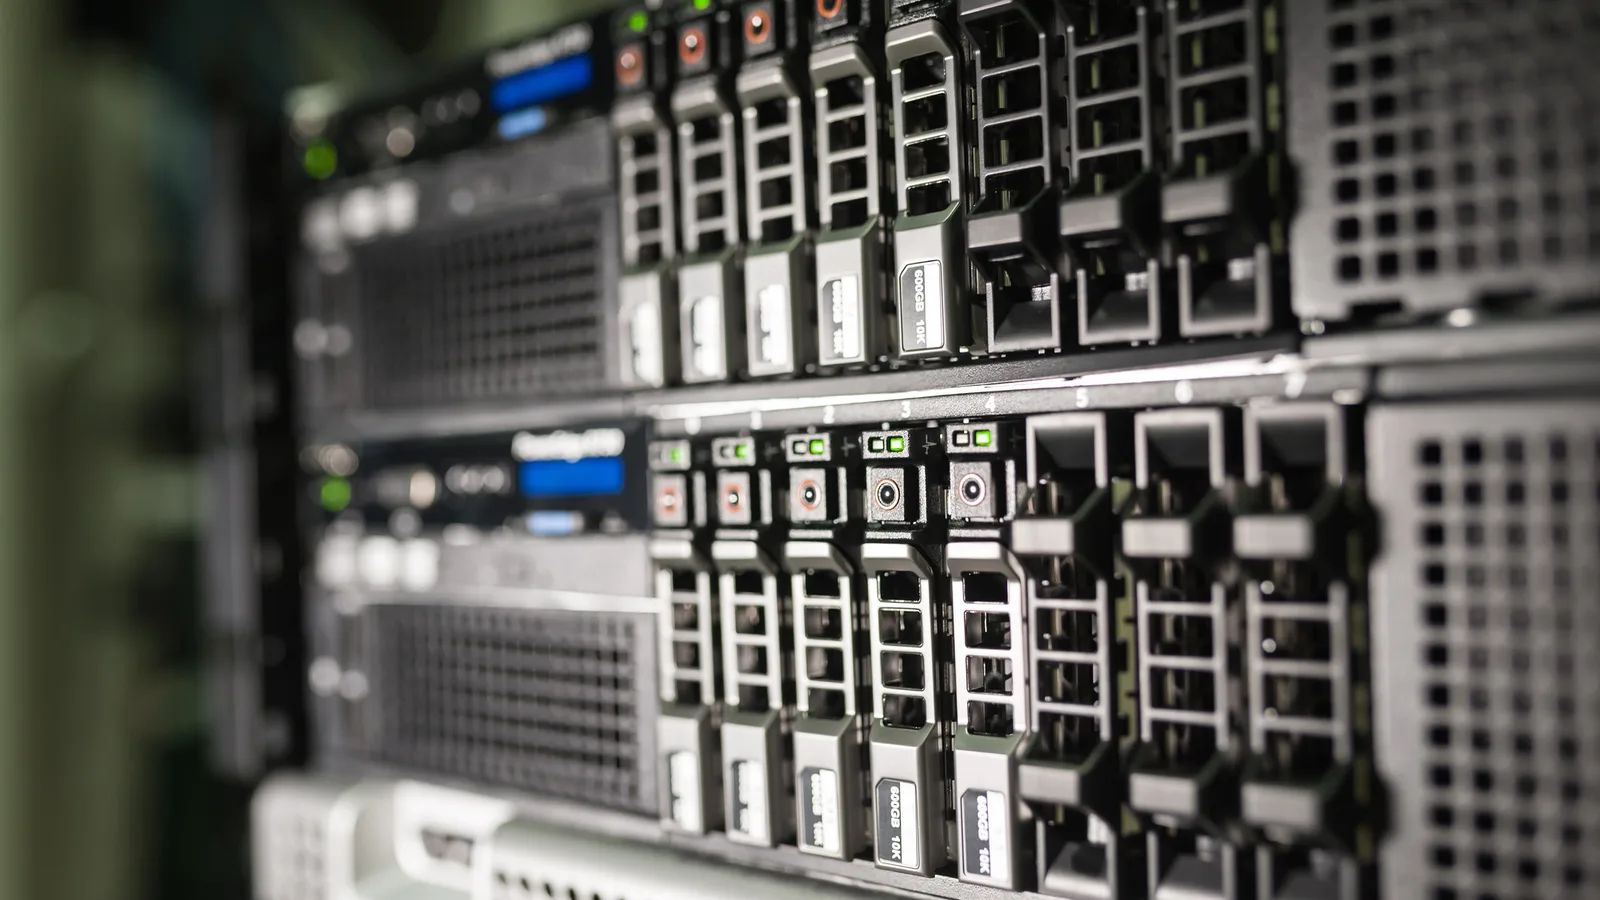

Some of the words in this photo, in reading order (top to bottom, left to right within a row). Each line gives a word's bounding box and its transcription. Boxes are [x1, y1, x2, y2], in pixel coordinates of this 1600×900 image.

[914, 270, 925, 312] 600GB
[916, 320, 925, 344] 10K
[901, 400, 912, 419] 3
[985, 396, 996, 412] 4
[1075, 387, 1090, 408] 5
[890, 786, 900, 828] 600GB
[977, 795, 988, 841] 600GB
[891, 836, 901, 860] 10K
[979, 848, 989, 873] 10K
